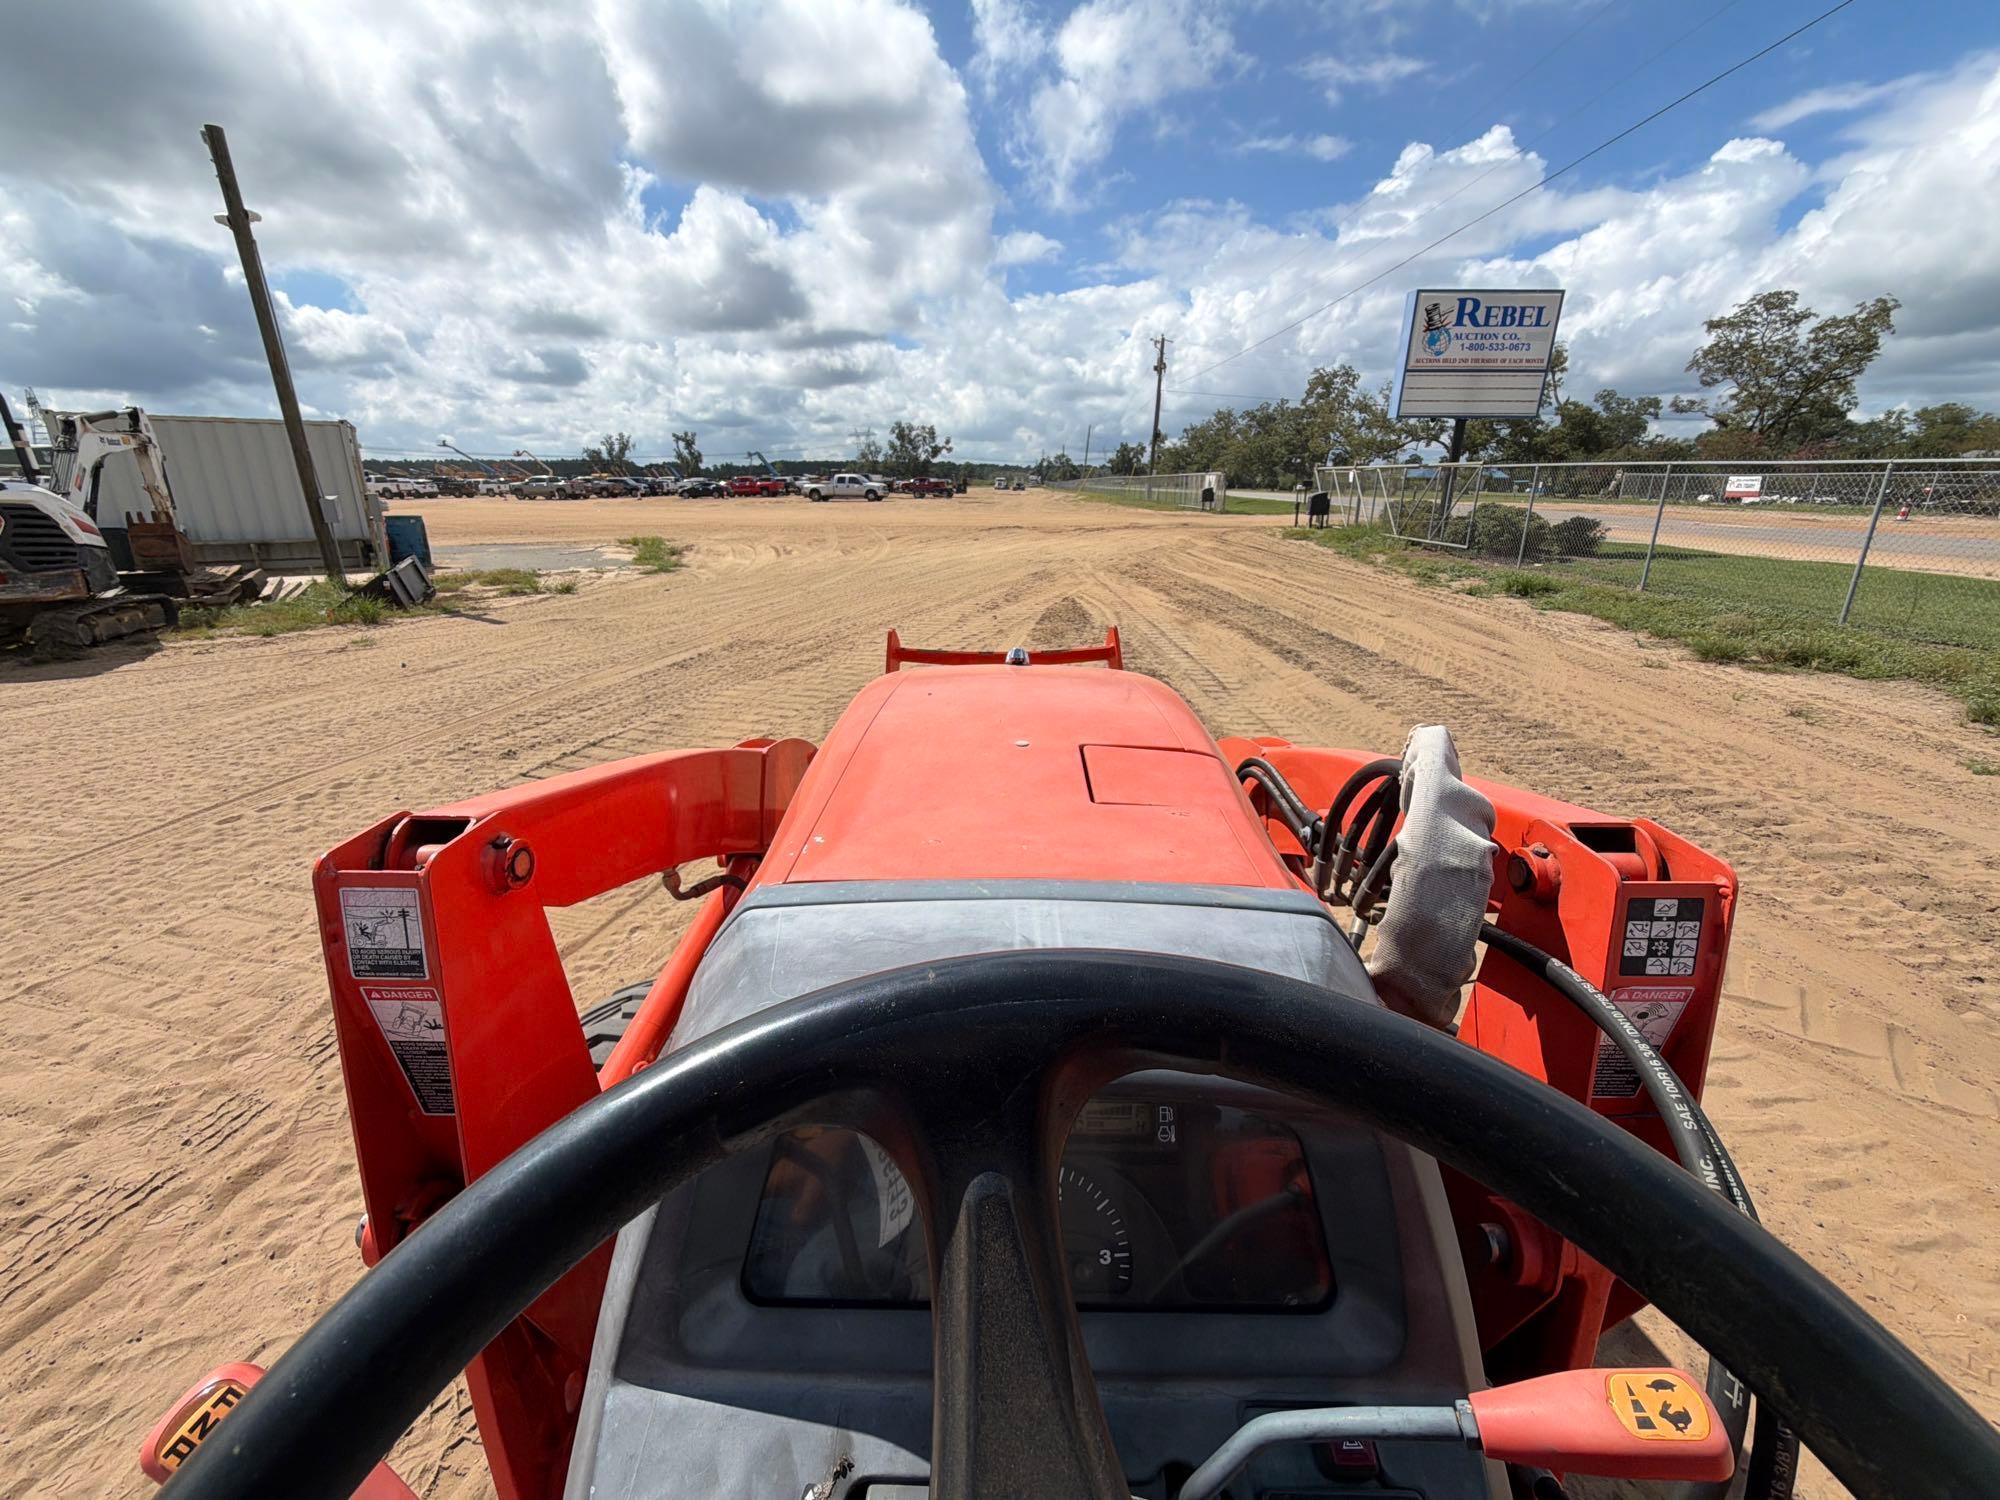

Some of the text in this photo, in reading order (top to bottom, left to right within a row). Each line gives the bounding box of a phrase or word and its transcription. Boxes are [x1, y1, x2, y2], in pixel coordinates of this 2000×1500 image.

[1452, 297, 1551, 328] REBEL
[1453, 332, 1520, 341] AUCTION CO.
[1460, 343, 1531, 351] 1-800-533-0673
[381, 990, 433, 1000] DANGER
[1631, 991, 1685, 1000] DANGER
[1649, 1059, 1682, 1099] 100R16
[1675, 1103, 1698, 1130] SAE
[1700, 1154, 1721, 1190] INC.
[1099, 1249, 1112, 1264] 3
